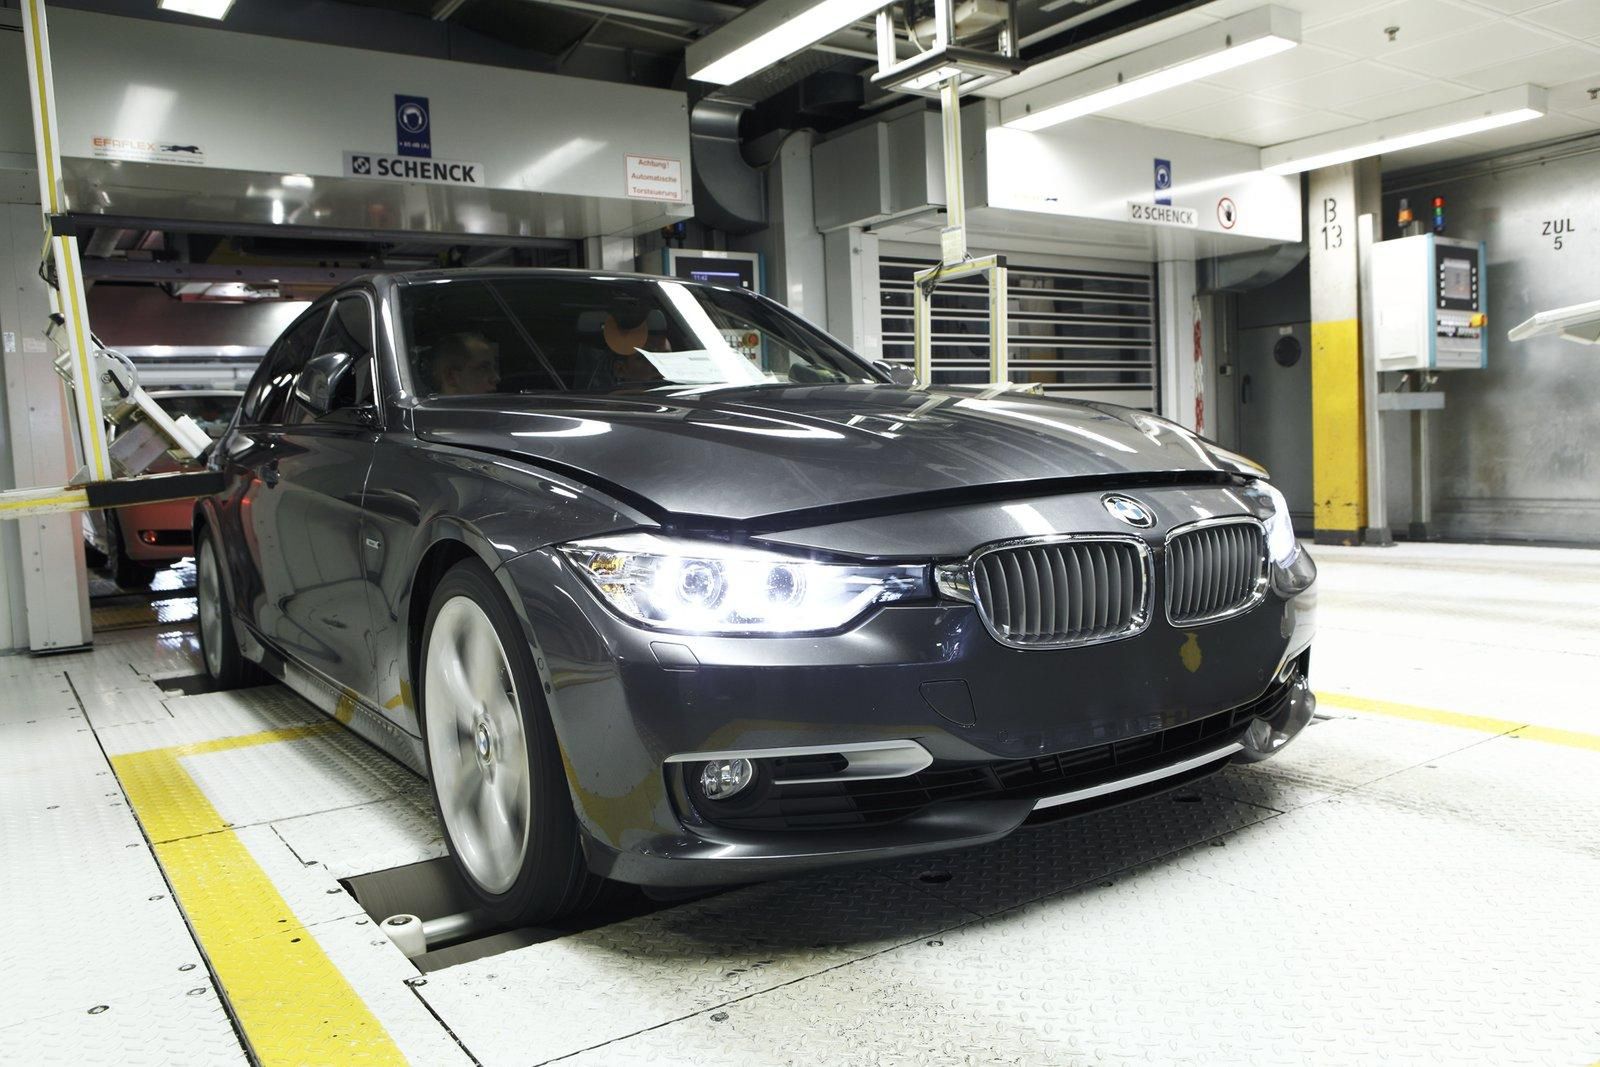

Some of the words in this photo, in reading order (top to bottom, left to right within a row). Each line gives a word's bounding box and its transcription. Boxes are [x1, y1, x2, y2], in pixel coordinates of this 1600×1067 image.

[376, 158, 476, 183] SCHENCK
[631, 172, 678, 183] Automatische
[632, 186, 678, 199] Torsteuerung
[1144, 206, 1194, 225] SCHENCK
[1323, 198, 1337, 223] B
[1542, 218, 1575, 236] ZUL
[1322, 224, 1343, 251] 13
[1553, 235, 1563, 251] 5
